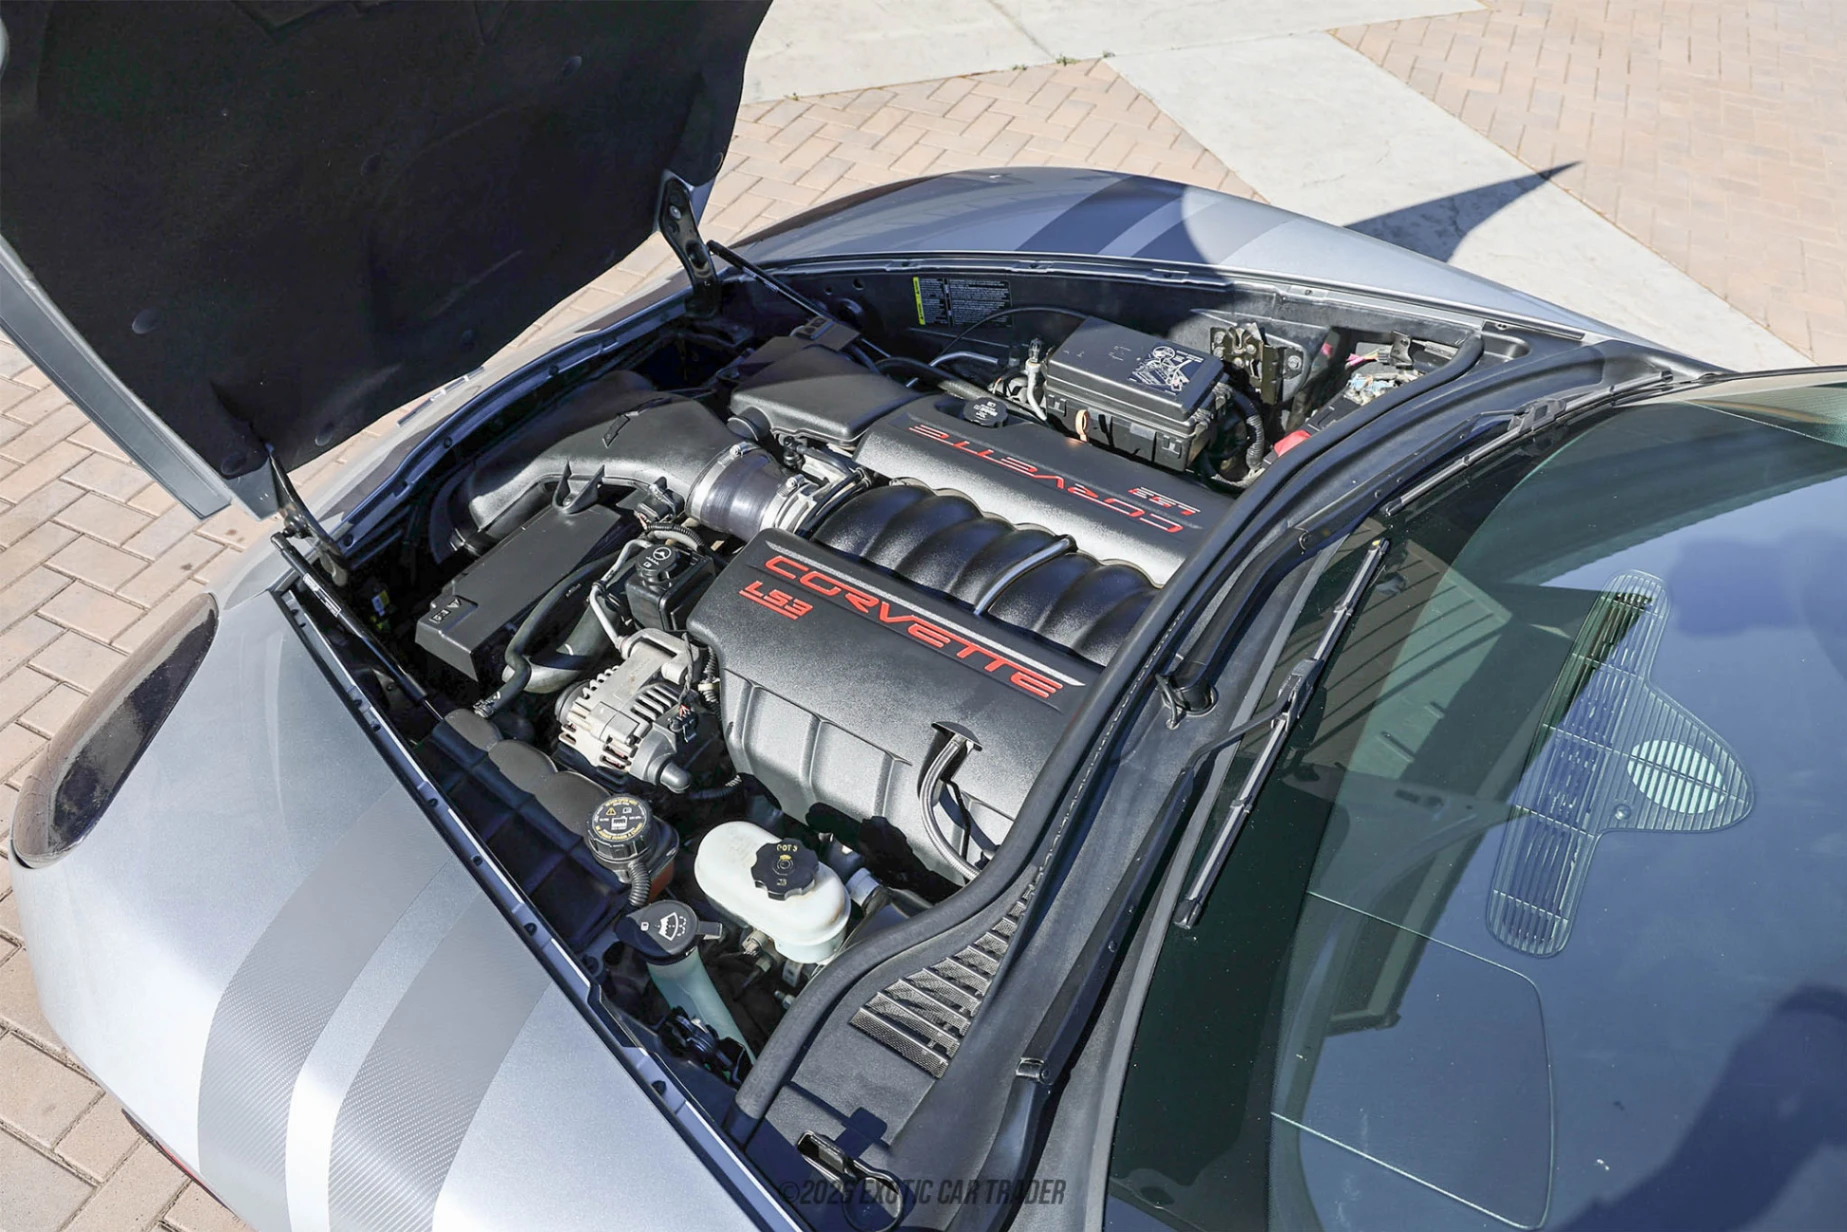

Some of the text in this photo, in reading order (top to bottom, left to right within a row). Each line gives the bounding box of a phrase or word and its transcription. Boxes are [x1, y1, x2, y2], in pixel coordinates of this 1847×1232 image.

[909, 425, 1183, 532] CORVETTE
[1128, 487, 1201, 516] LS3
[739, 581, 813, 620] LS3
[765, 556, 1063, 698] CORVETTE
